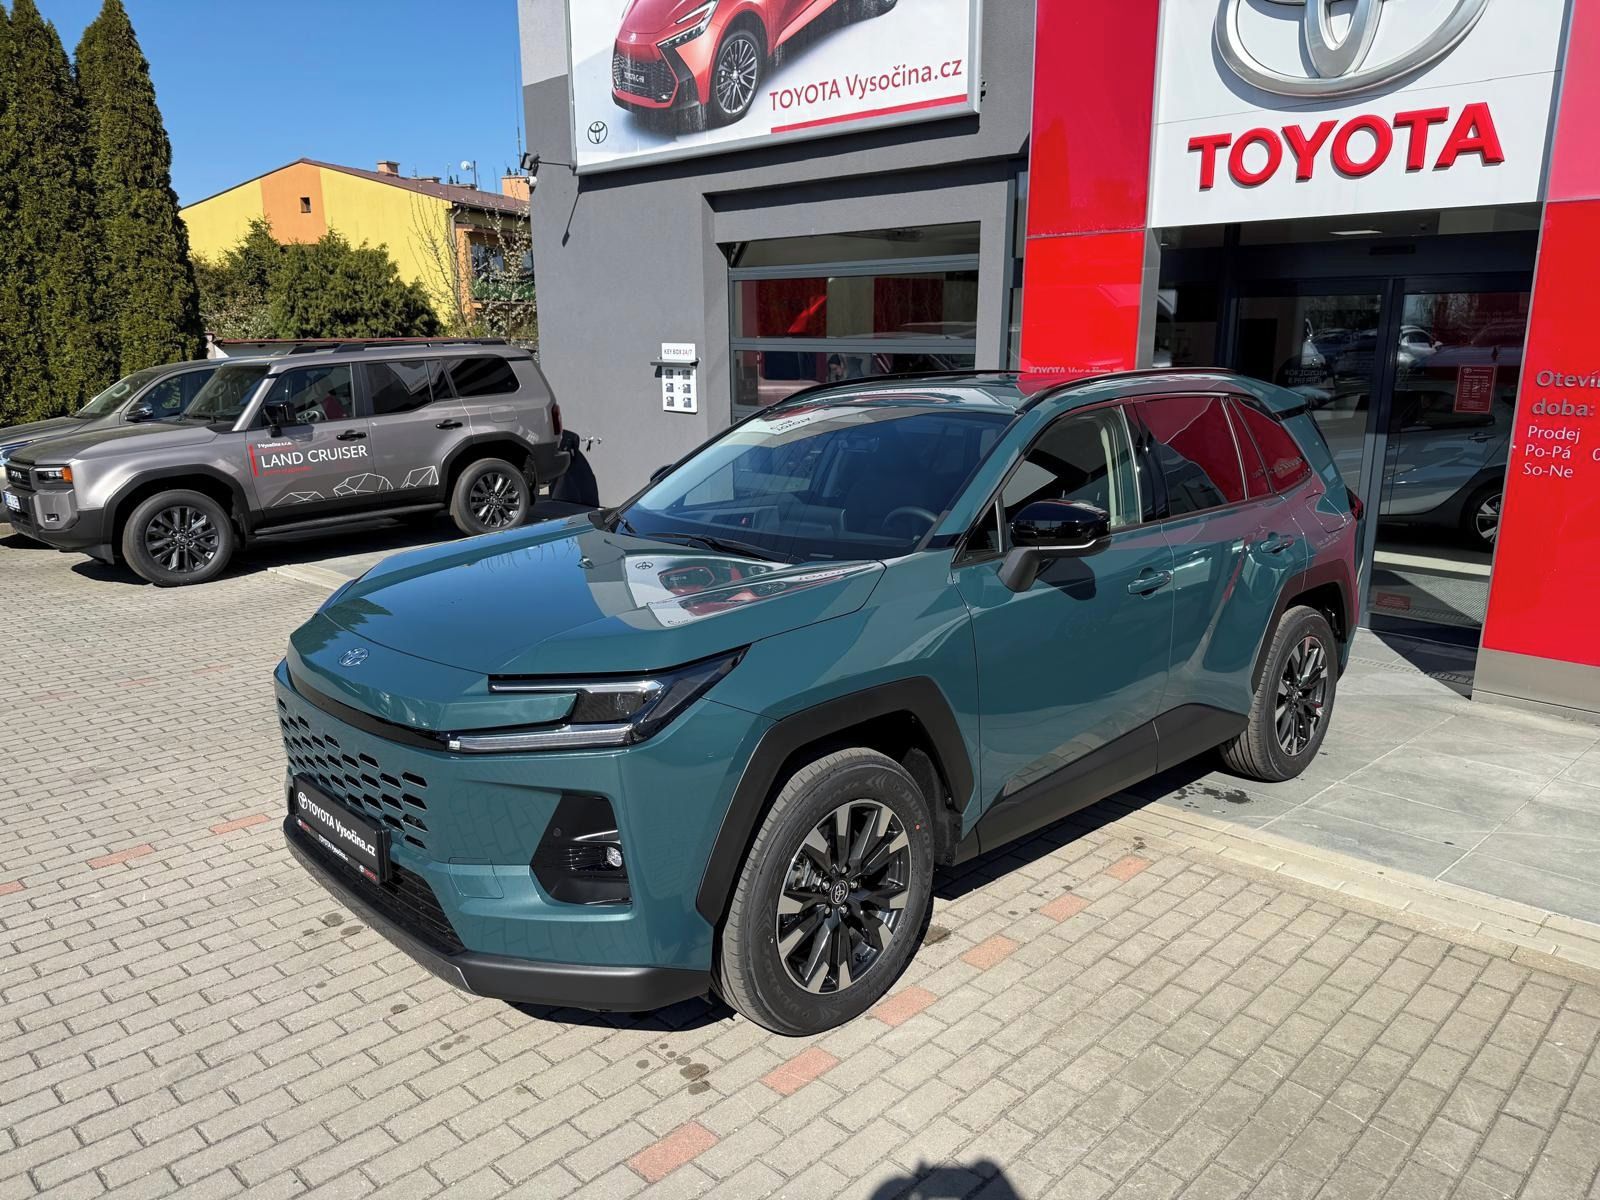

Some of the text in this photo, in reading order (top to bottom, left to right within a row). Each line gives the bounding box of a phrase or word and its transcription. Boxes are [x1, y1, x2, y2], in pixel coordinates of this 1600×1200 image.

[769, 59, 962, 111] TOYOTA Vysočina.cz
[1187, 102, 1504, 191] TOYOTA
[1531, 398, 1595, 416] doba:
[1528, 425, 1581, 444] Prodej
[261, 452, 304, 468] LAND
[307, 445, 368, 463] CRUISER
[1525, 444, 1571, 460] Po-Pá
[1523, 462, 1573, 478] So-Ne
[307, 799, 376, 857] TOYOTA Vysočina.cz
